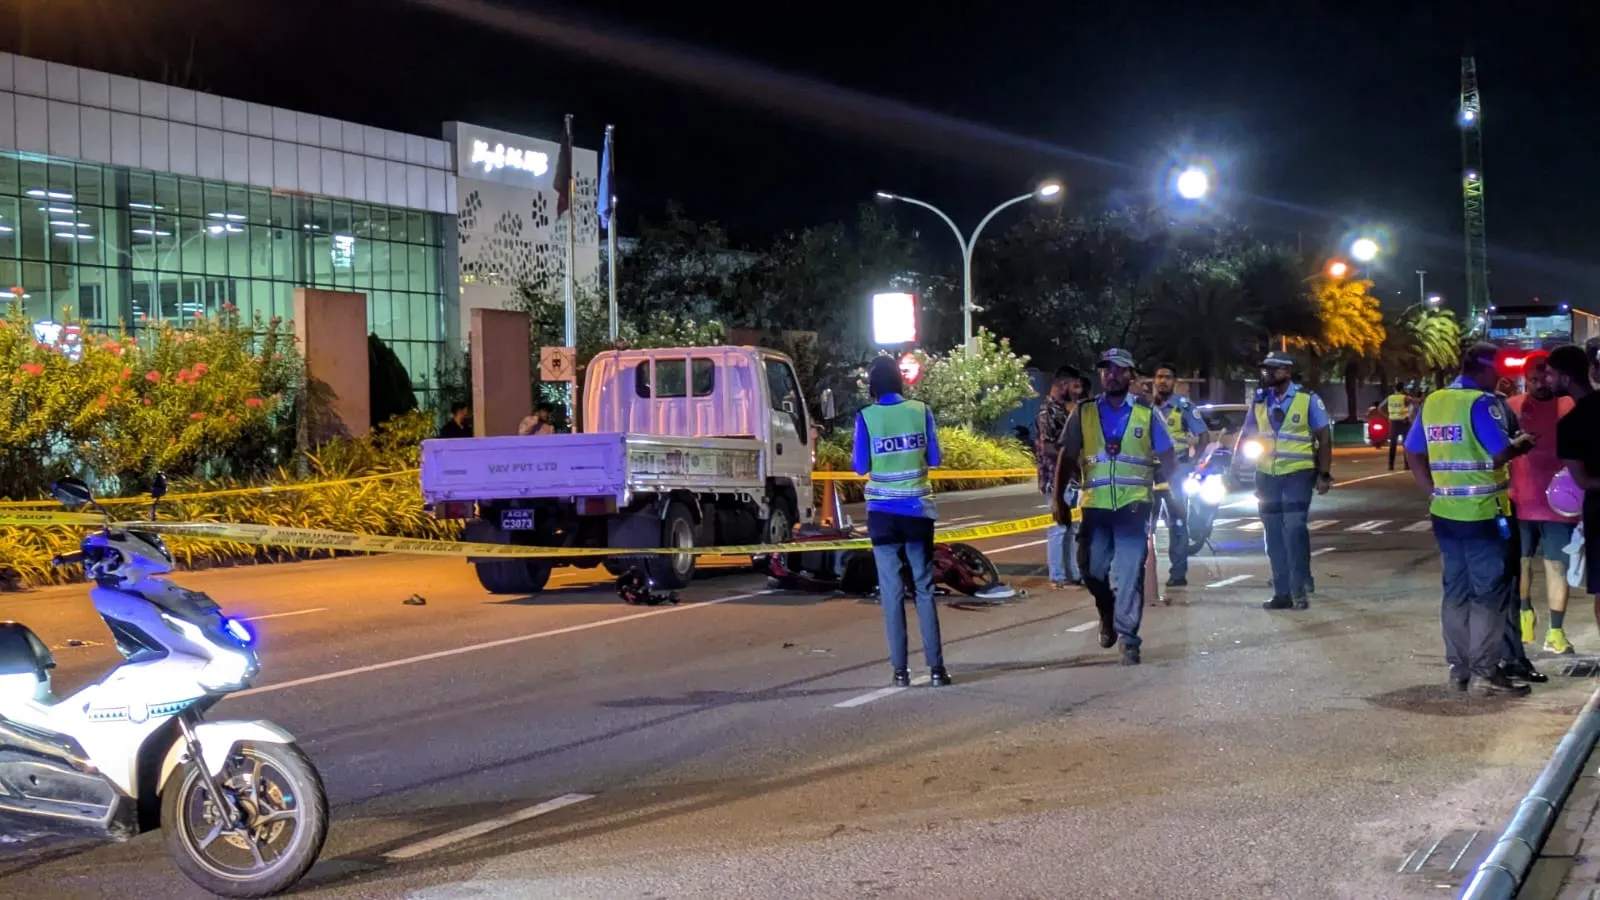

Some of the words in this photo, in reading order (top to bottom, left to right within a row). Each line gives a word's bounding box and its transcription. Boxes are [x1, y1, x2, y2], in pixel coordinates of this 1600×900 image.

[874, 434, 925, 453] POLICE
[512, 463, 533, 473] PVT
[537, 462, 558, 472] LTD
[503, 519, 532, 529] C3073
